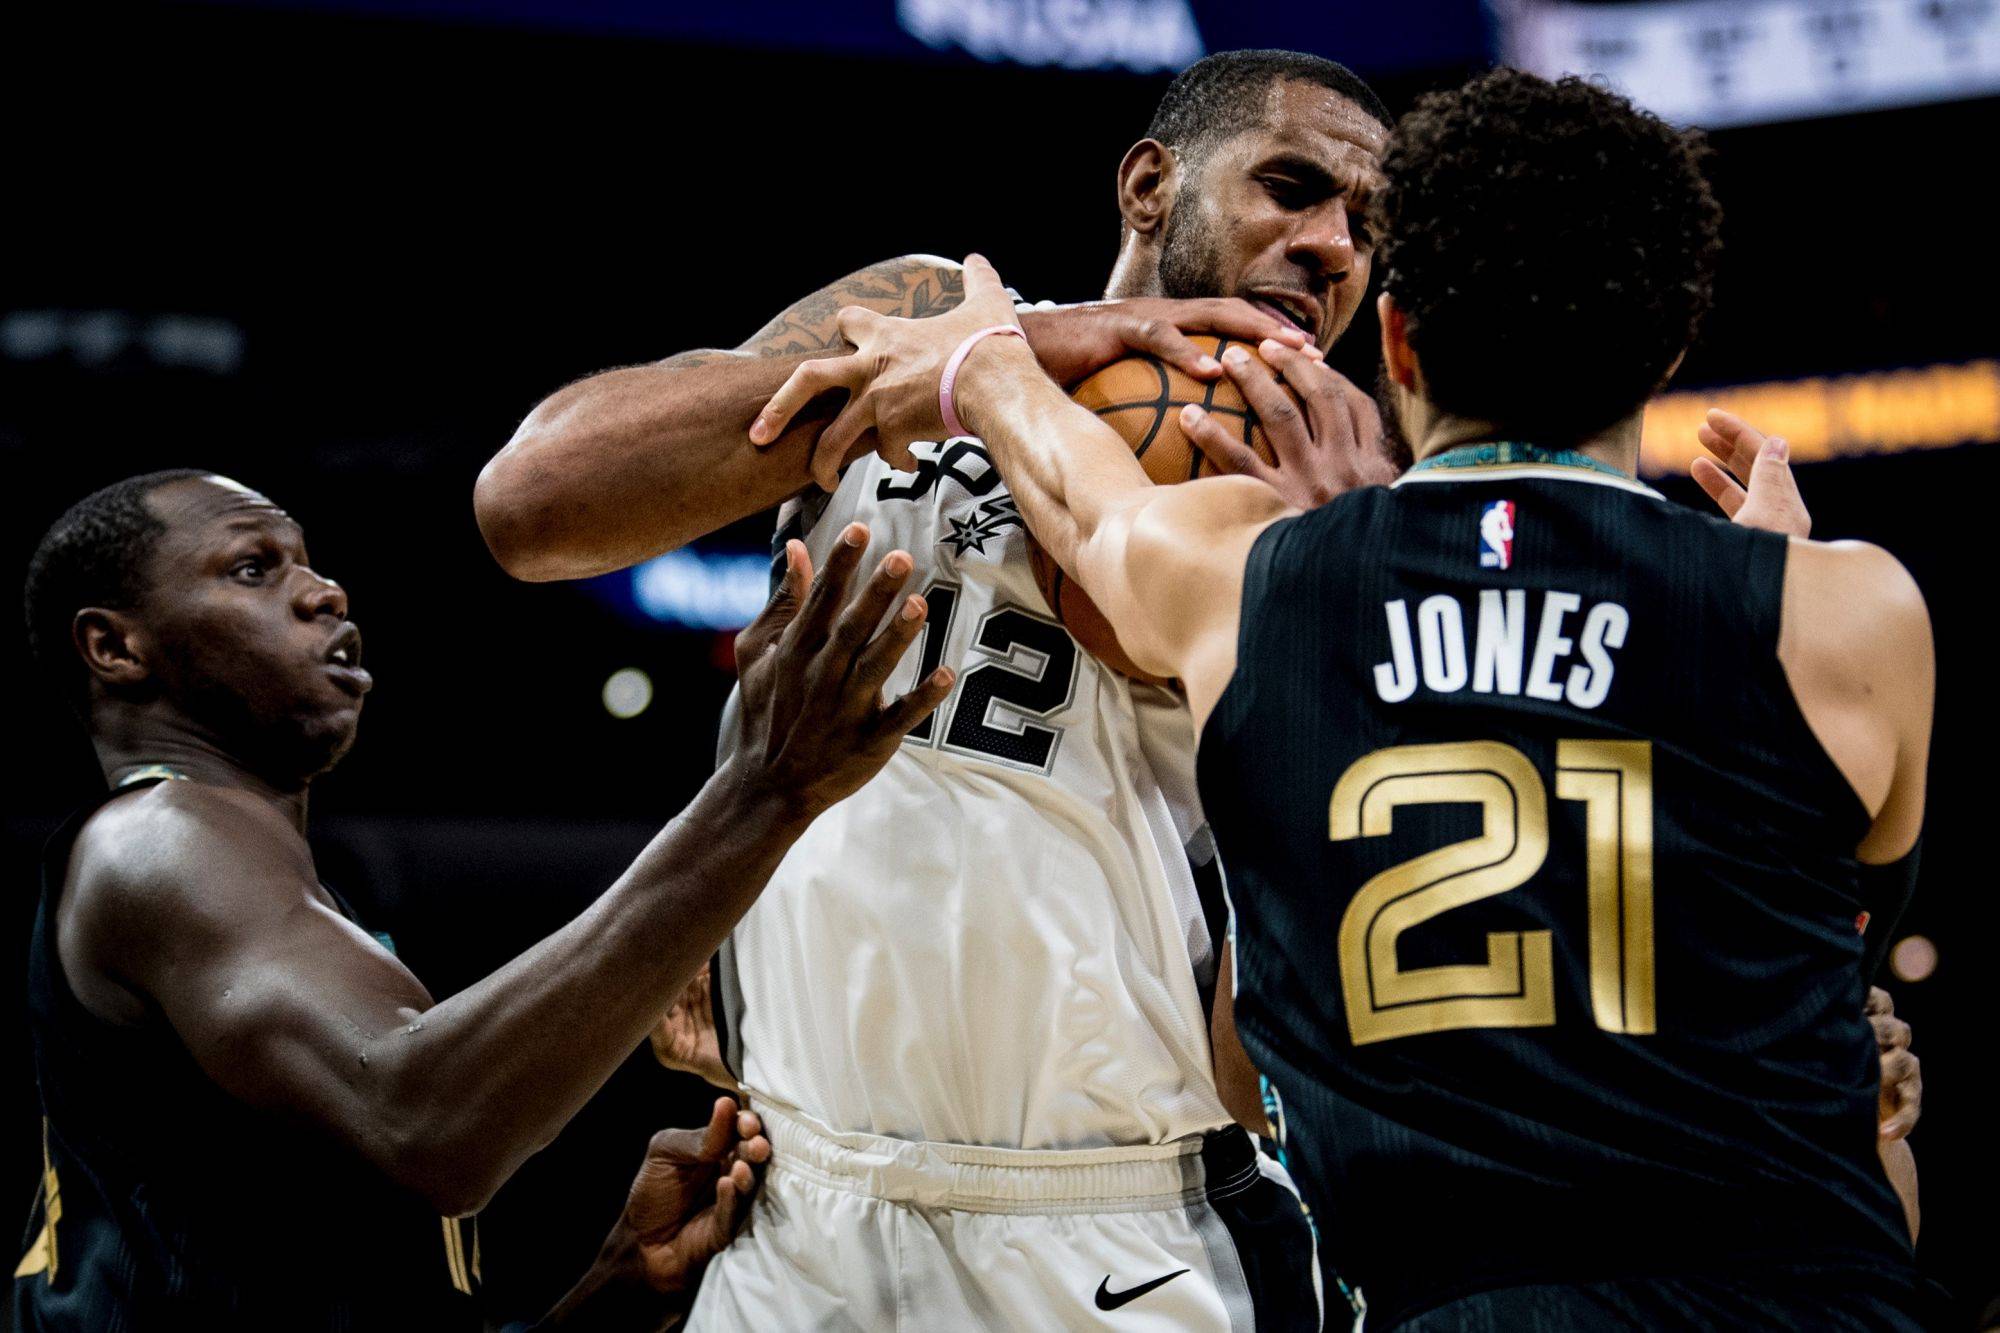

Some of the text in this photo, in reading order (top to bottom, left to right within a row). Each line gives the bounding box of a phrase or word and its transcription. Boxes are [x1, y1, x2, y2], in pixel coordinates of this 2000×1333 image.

[896, 579, 1082, 777] 12
[1373, 589, 1630, 709] JONES
[1329, 739, 1656, 1046] 21
